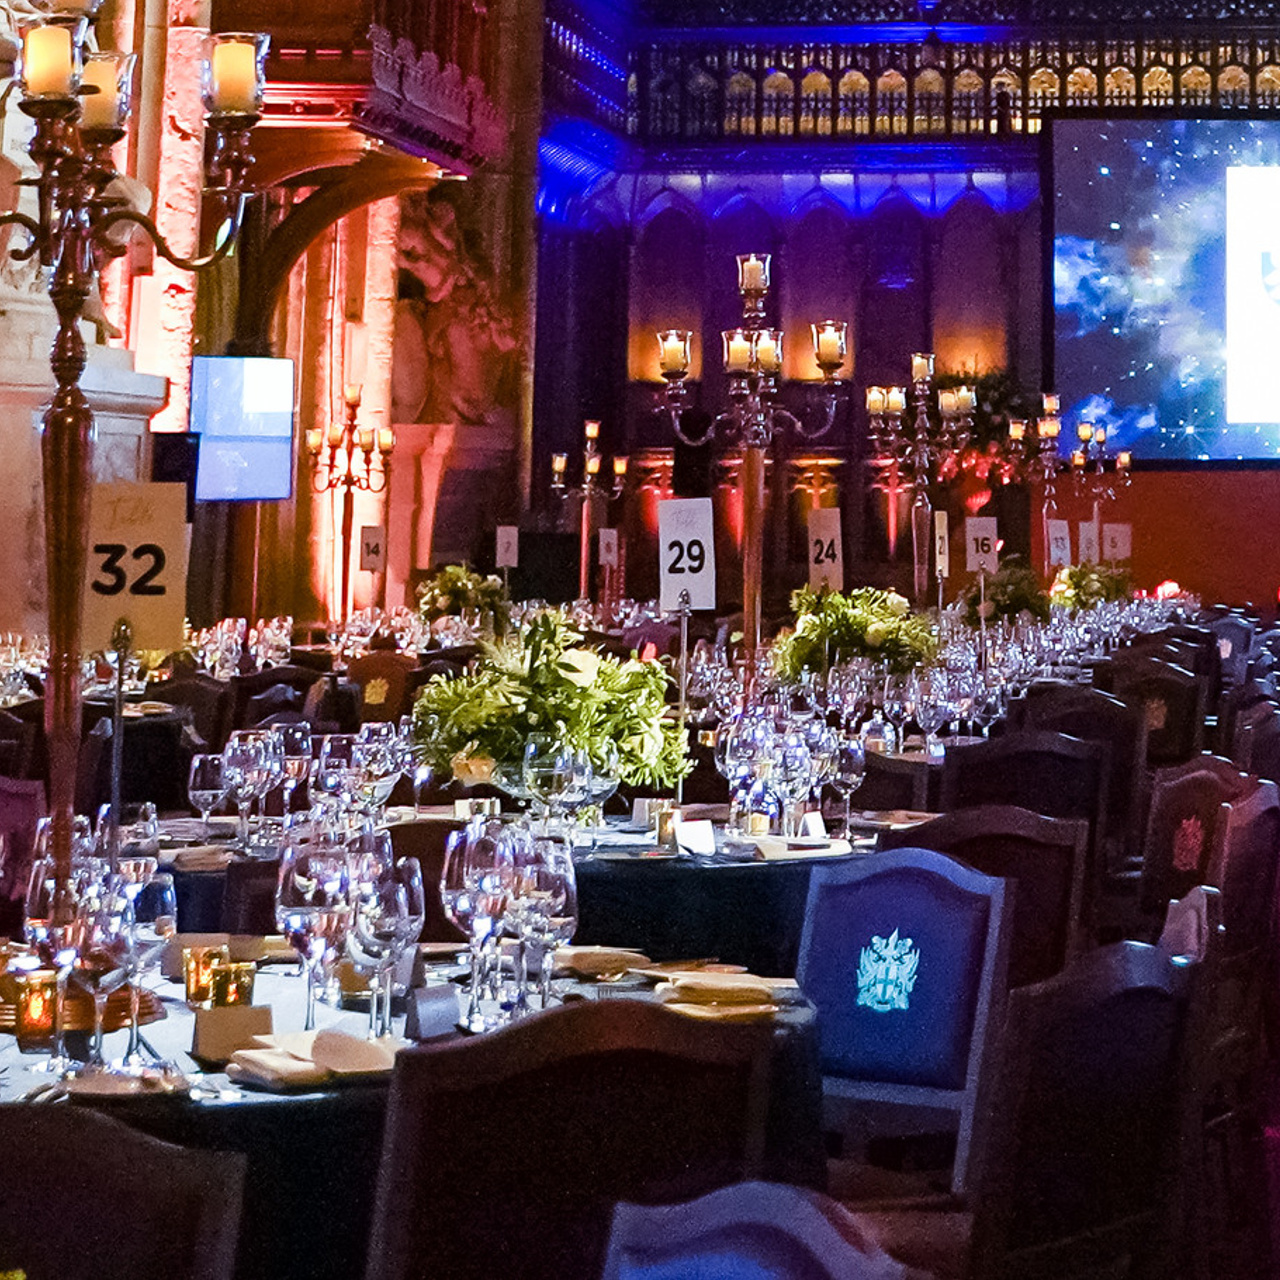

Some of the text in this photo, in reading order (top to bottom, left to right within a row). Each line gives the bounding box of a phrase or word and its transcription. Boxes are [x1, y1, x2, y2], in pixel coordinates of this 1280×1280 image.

[365, 542, 380, 557] 14
[668, 539, 706, 574] 29
[813, 538, 837, 565] 24
[973, 537, 992, 554] 16
[91, 544, 167, 596] 32
